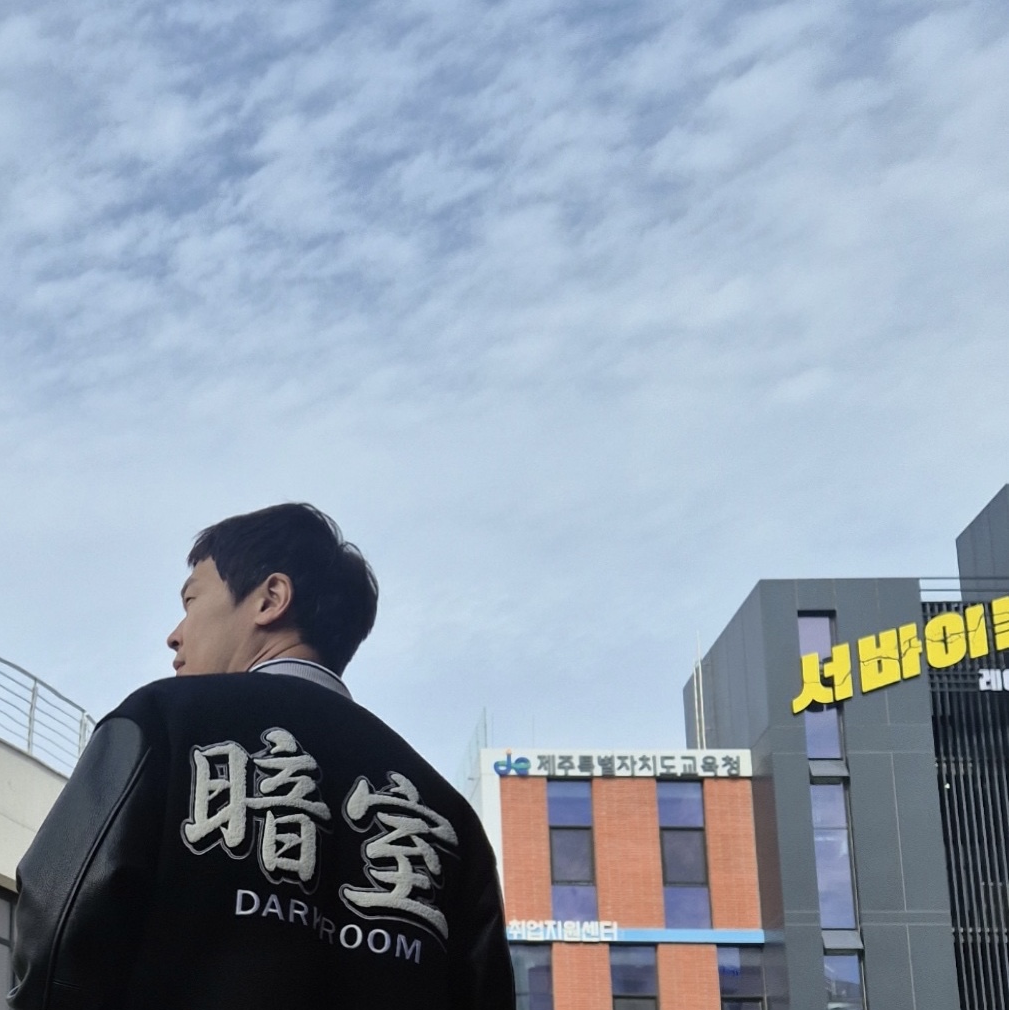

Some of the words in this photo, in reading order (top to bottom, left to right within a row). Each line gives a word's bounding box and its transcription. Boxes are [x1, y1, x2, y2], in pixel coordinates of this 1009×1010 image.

[537, 755, 741, 777] 제주특별자치도교육청
[181, 727, 459, 950] 暗室
[508, 918, 618, 942] 취업지원센터
